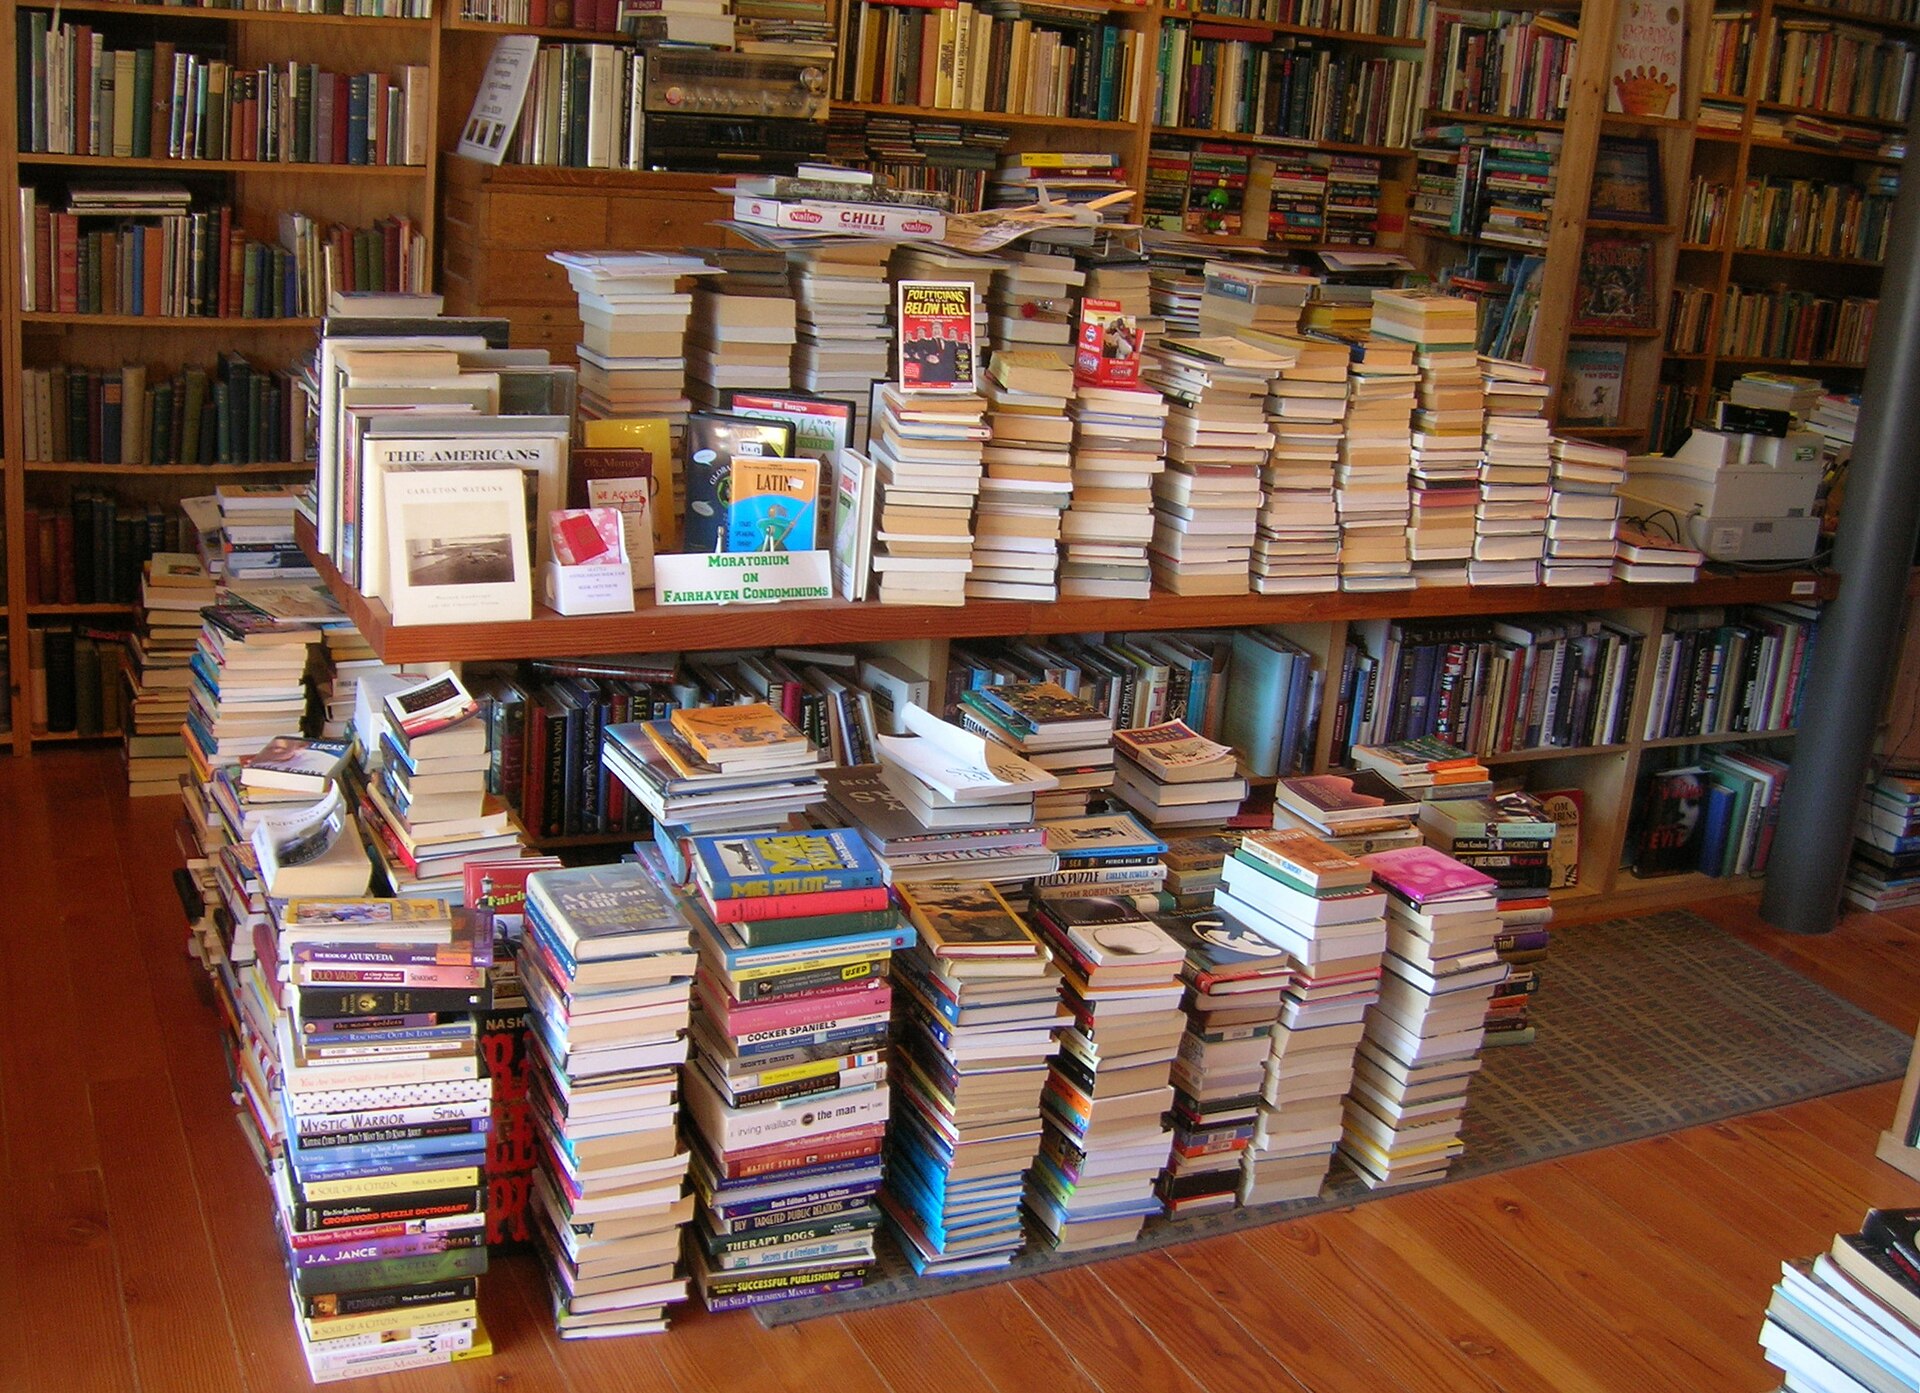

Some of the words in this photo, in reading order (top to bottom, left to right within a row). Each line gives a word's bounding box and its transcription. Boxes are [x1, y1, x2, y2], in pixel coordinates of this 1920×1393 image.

[790, 212, 821, 223] Nalley
[840, 212, 886, 226] CHILI
[902, 223, 931, 234] Nalley
[907, 289, 966, 303] POLITICIANS
[904, 302, 940, 315] BELOW
[942, 302, 970, 315] HELL
[384, 451, 424, 462] THE
[430, 449, 540, 462] AMERICANS
[756, 474, 792, 492] LATIN
[553, 720, 563, 753] DIVINA
[1082, 887, 1120, 897] ROBBINS
[348, 952, 394, 962] AYURVEDA
[312, 970, 333, 981] QUO
[845, 966, 867, 976] USED
[486, 1017, 525, 1030] NASH
[350, 1031, 385, 1041] REACHING
[747, 1030, 787, 1042] COCKER
[789, 1020, 837, 1035] SPANIELS
[740, 1059, 766, 1068] MONTE
[769, 1054, 795, 1064] CRISTO
[739, 1086, 793, 1103] DEMONIC
[798, 1075, 836, 1087] MALES
[432, 1108, 465, 1120] SPINA
[737, 1125, 762, 1136] irving
[764, 1118, 797, 1131] wallace
[817, 1110, 832, 1121] the
[836, 1105, 856, 1116] man
[301, 1118, 347, 1133] MYSTIC
[351, 1114, 405, 1128] WARRIOR
[318, 1186, 340, 1195] SOUL
[364, 1182, 397, 1191] CITIZEN
[322, 1212, 379, 1225] CROSSWORD
[381, 1209, 414, 1219] PUZZLE
[416, 1204, 469, 1216] DICTIONARY
[754, 1214, 785, 1227] TARGETED
[788, 1208, 811, 1220] PUBLIC
[813, 1201, 842, 1215] RELATIONS
[726, 1236, 779, 1252] THERAPY
[783, 1230, 815, 1242] DOGS
[305, 1254, 330, 1263] J.A.
[335, 1248, 376, 1260] JANCE
[737, 1279, 788, 1291] SUCCESSFUL
[790, 1271, 840, 1285] PUBLISHING
[714, 1299, 728, 1307] THE
[788, 1288, 816, 1297] MANUAL
[366, 1319, 399, 1329] CITIZEN
